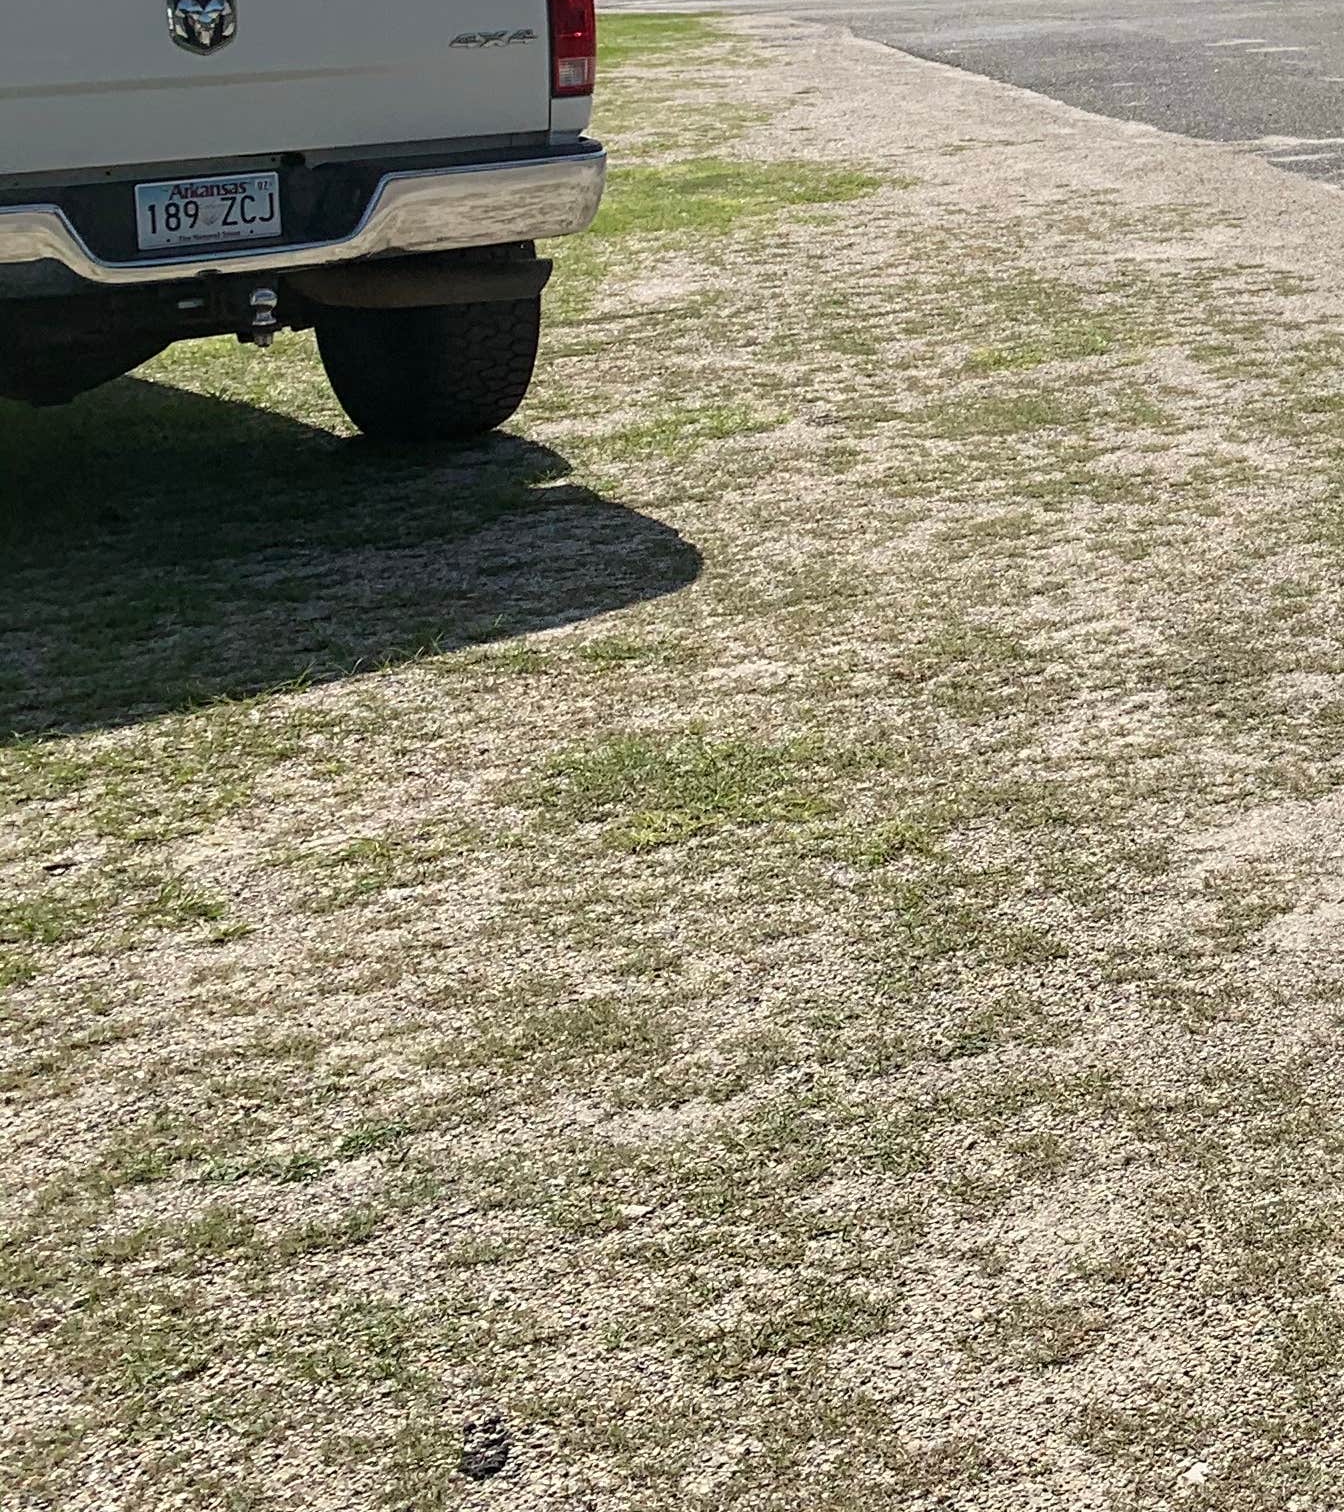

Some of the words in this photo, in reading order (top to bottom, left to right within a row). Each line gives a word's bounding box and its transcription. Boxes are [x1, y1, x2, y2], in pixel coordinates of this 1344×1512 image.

[168, 181, 248, 201] Arkansas
[147, 200, 200, 234] 189
[221, 192, 275, 227] ZCJ
